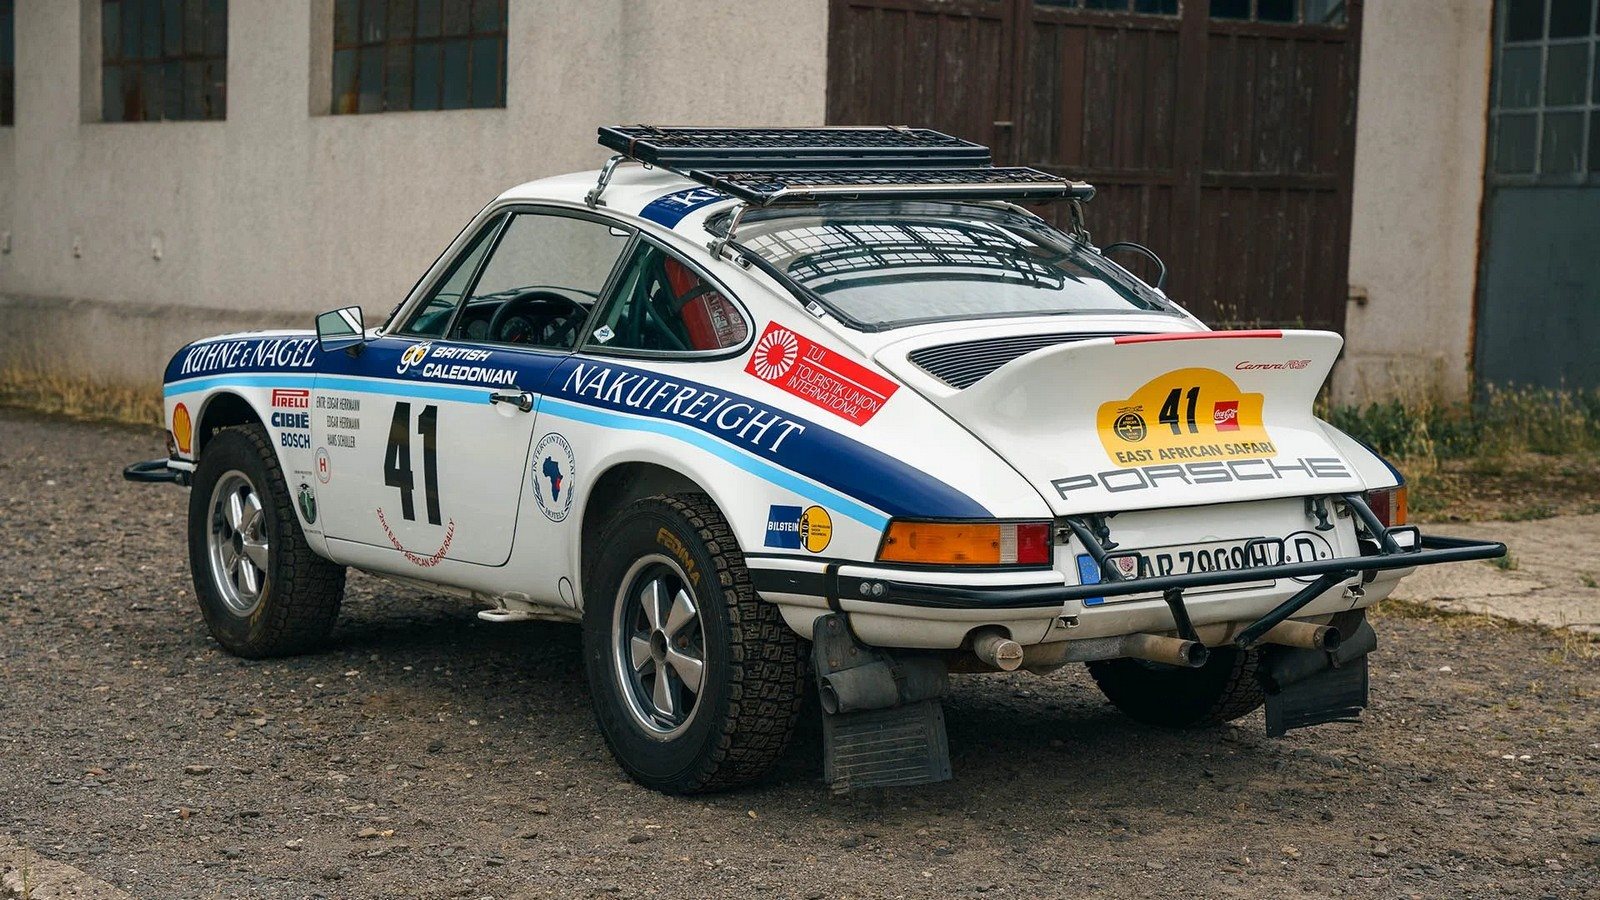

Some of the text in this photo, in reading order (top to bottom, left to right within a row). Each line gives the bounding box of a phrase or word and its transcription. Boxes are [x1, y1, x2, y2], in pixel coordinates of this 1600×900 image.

[248, 339, 319, 367] NAGEL
[431, 346, 493, 362] BRITISH
[806, 345, 828, 363] TUI
[422, 363, 518, 385] CALEDONIAN
[794, 363, 882, 413] TOURISTIK UNION
[271, 389, 310, 408] PIRELLI
[562, 363, 806, 453] NAKUFREIGHT
[786, 376, 862, 419] INTERNATIONAL
[1158, 386, 1200, 436] 41
[281, 432, 310, 449] BOSCH
[1115, 442, 1276, 464] EAST AFRICAN SAFARI
[319, 458, 327, 472] H
[384, 401, 442, 526] 41
[532, 435, 575, 475] INTERCONTINENTAL
[1050, 457, 1352, 501] PORSCHE
[376, 507, 389, 532] 22nd
[404, 551, 431, 568] AFRICAN
[444, 518, 455, 550] RALLY
[768, 521, 799, 532] BILSTEIN
